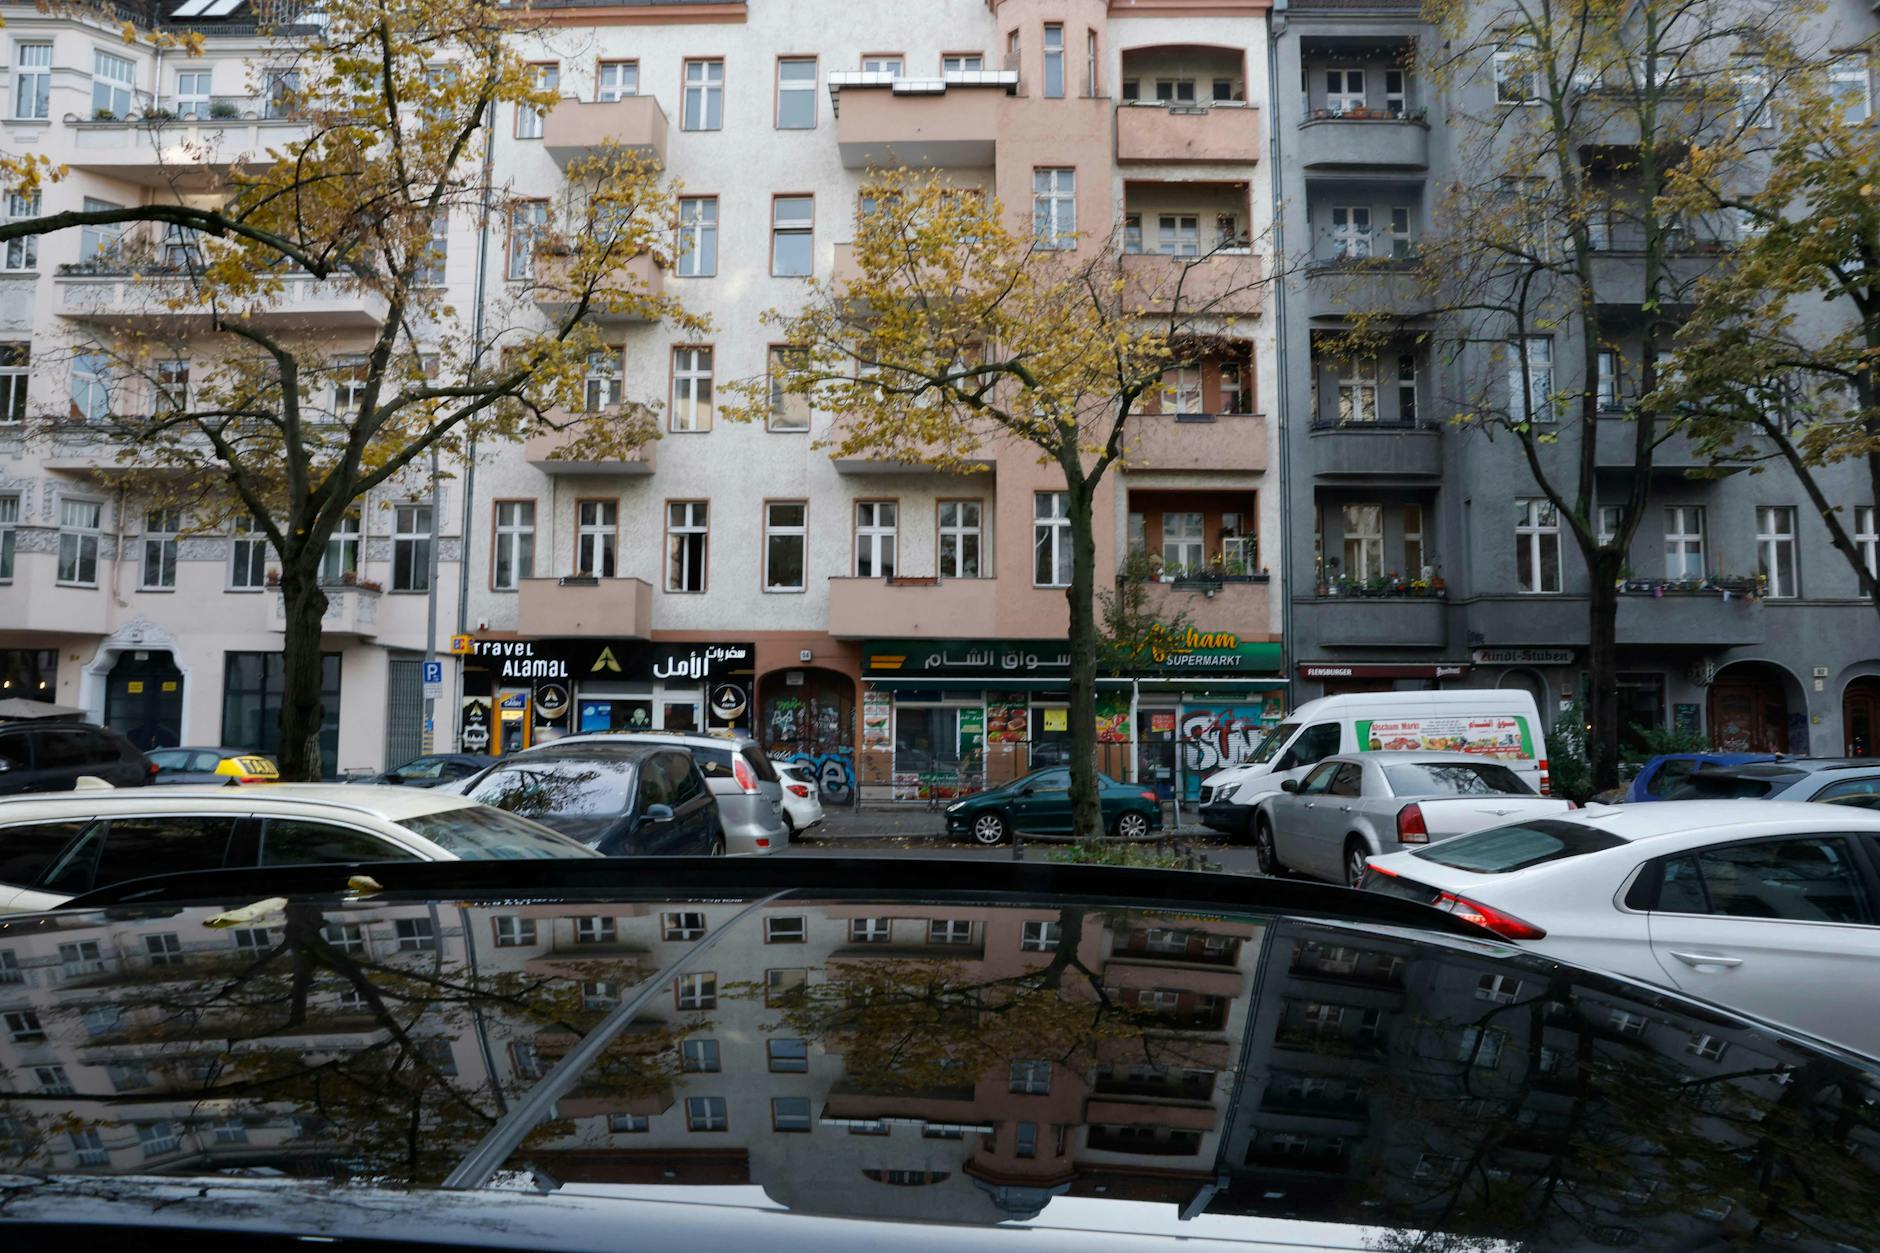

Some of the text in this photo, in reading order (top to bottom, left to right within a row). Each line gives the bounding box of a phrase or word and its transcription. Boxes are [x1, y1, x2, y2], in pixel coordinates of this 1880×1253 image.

[705, 646, 746, 661] سفريات
[924, 648, 994, 669] الشام
[1166, 655, 1242, 666] SUPERMARKT
[427, 664, 438, 680] P
[653, 651, 709, 679] الأمل
[1308, 668, 1352, 676] FLENSBURGER
[242, 759, 279, 775] TAXI
